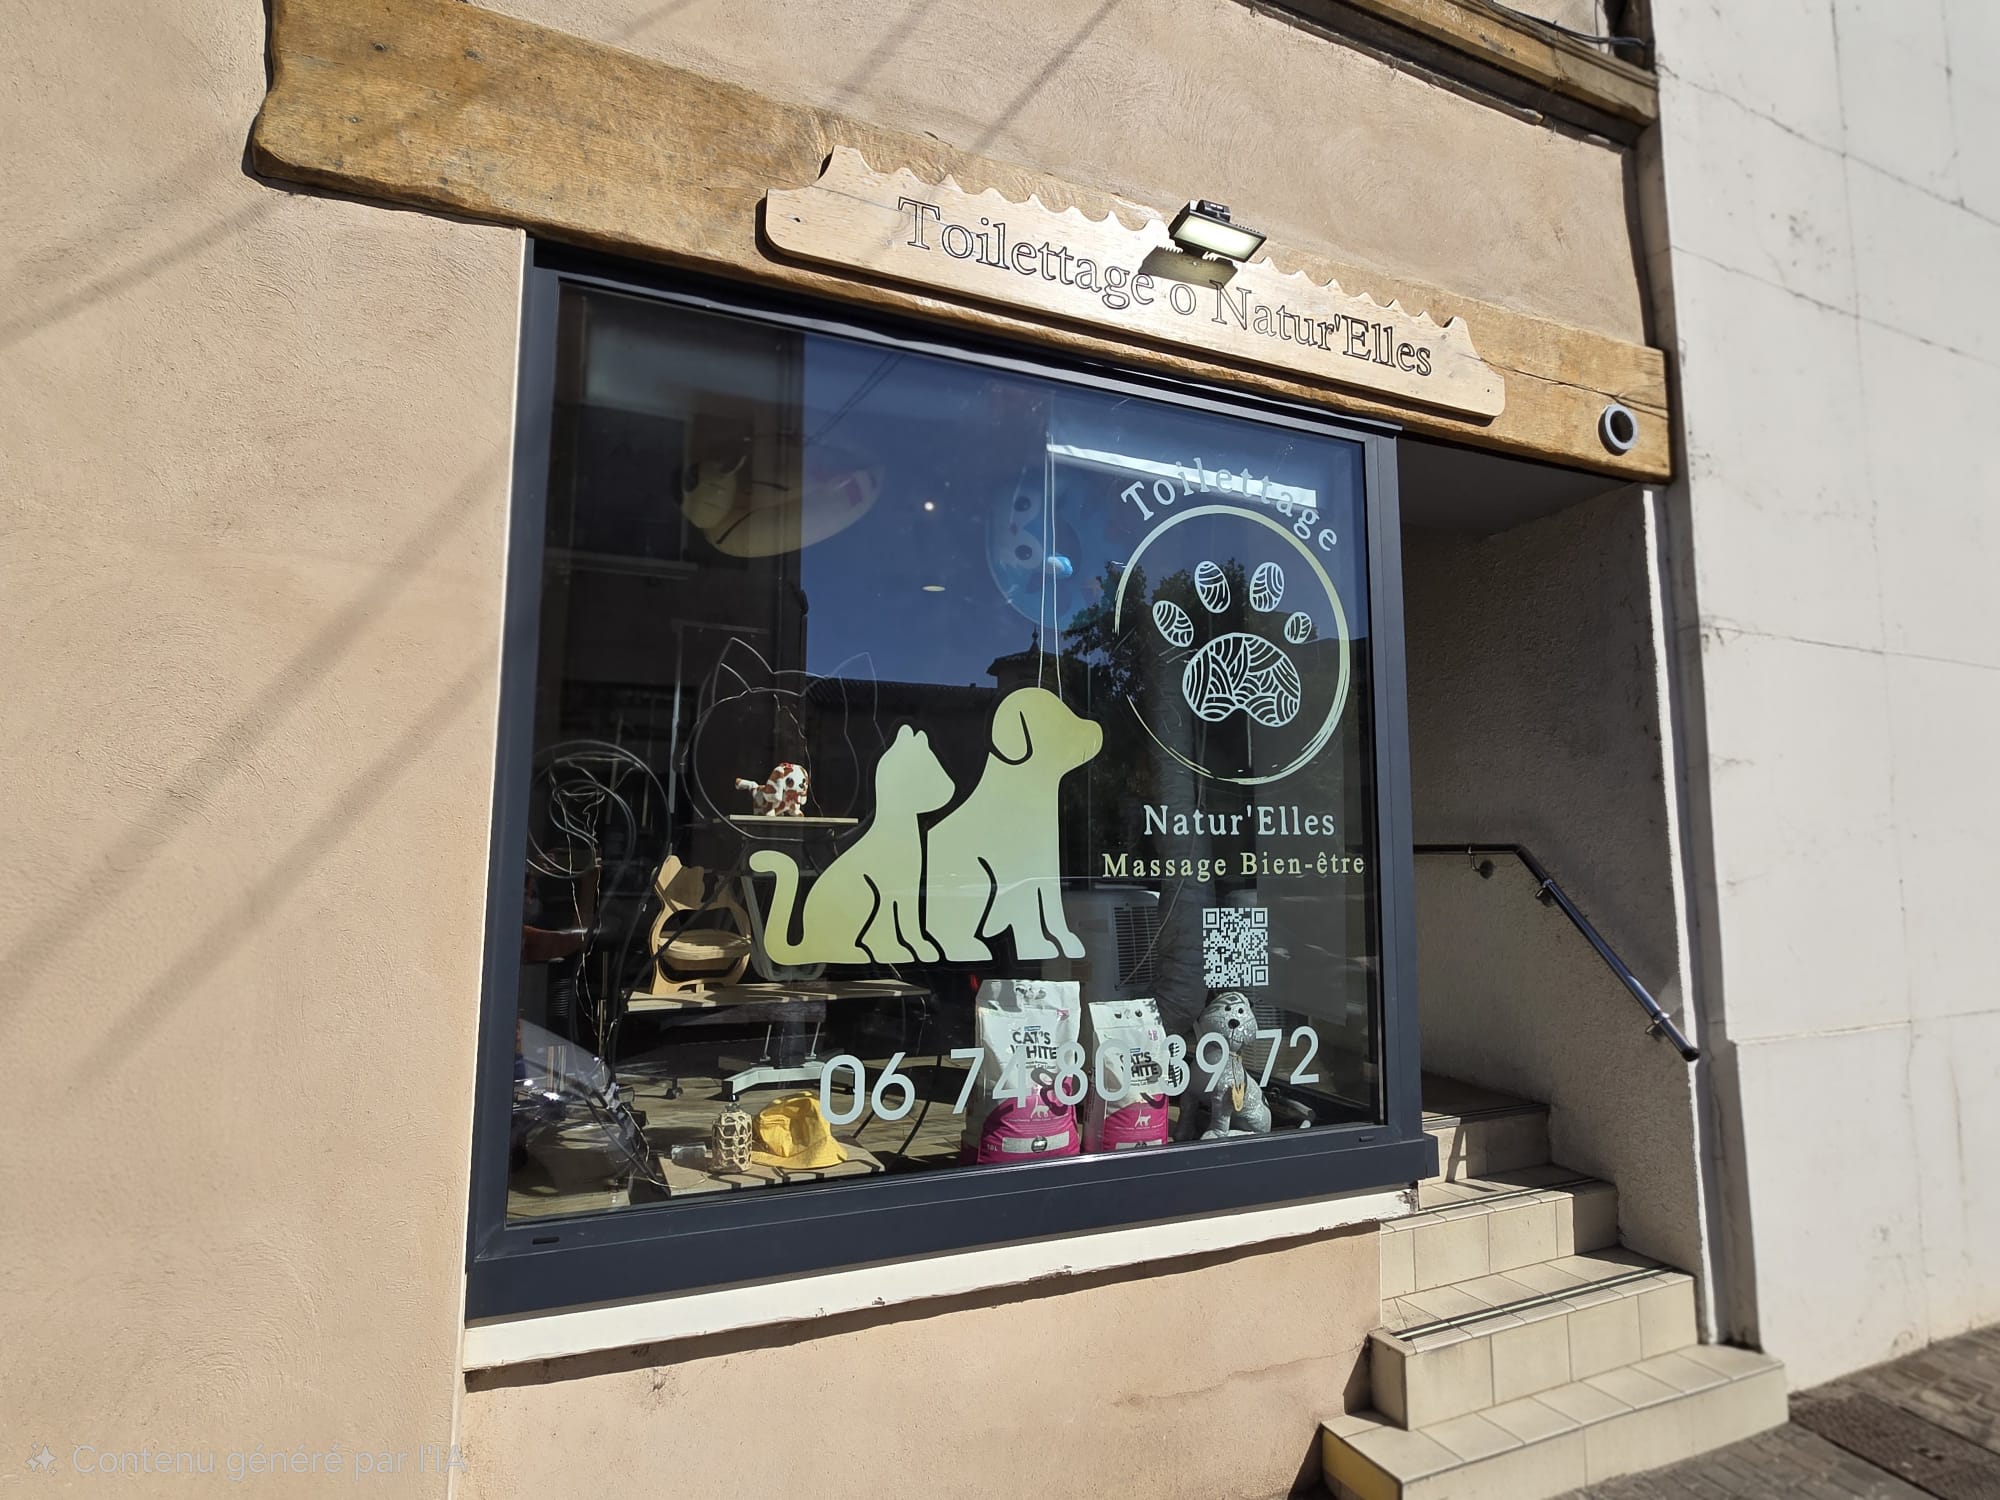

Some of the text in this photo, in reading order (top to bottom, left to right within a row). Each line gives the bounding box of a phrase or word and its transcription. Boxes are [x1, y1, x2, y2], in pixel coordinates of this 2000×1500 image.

[897, 196, 1155, 310] Toilettage
[1210, 279, 1433, 377] Natur'Elles
[1120, 457, 1338, 551] Toilettage
[1143, 804, 1336, 836] Natur'Elles
[1102, 851, 1366, 882] Massage Bien-être
[1010, 1044, 1059, 1060] HITE
[1012, 1031, 1051, 1045] CAT'S
[819, 1026, 1320, 1125] 06 74 80 39 72
